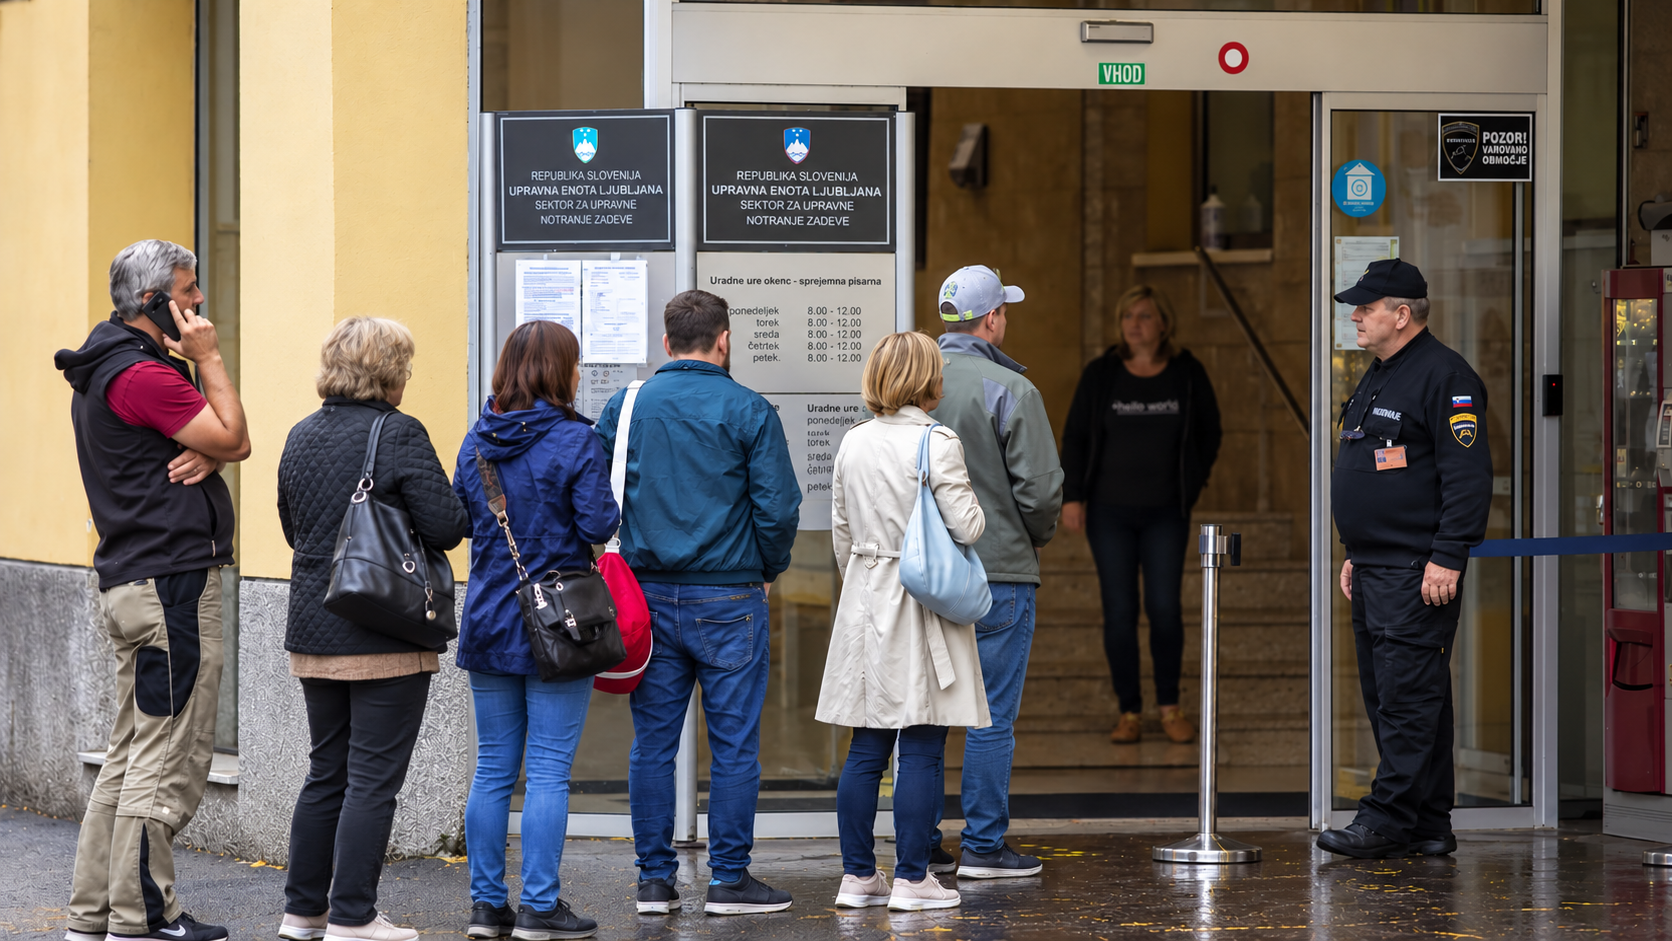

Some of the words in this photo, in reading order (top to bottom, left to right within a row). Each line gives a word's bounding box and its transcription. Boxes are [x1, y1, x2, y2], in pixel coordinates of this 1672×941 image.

[1103, 65, 1142, 83] VHOD
[1482, 131, 1527, 144] POZOR!
[531, 170, 585, 181] REPUBLIKA
[587, 170, 642, 181] SLOVENIJA
[736, 170, 797, 181] REPUBLIKA
[799, 171, 858, 182] SLOVENIJA
[509, 185, 559, 196] UPRAVNA
[561, 185, 597, 196] ENOTA
[599, 184, 663, 195] LJUBLJANA
[711, 184, 767, 196] UPRAVNA
[770, 185, 810, 196] ENOTA
[812, 186, 882, 197] LJUBLJANA
[535, 199, 574, 210] SEKTOR
[576, 199, 589, 210] ZA
[590, 199, 637, 210] UPRAVNE
[740, 199, 785, 211] SEKTOR
[786, 200, 801, 211] ZA
[803, 200, 854, 211] UPRAVNE
[540, 214, 592, 225] NOTRANJE
[594, 214, 633, 225] ZADEVE
[746, 215, 804, 226] NOTRANJE
[806, 215, 850, 226] ZADEVE
[709, 276, 745, 285] Uradne
[763, 276, 792, 285] okenc
[798, 276, 847, 288] sprejemna
[848, 276, 882, 288] pisarna
[729, 306, 780, 317] ponedeljek
[807, 306, 828, 316] 8.00
[837, 306, 862, 316] 12.00
[756, 317, 780, 327] torek
[807, 317, 828, 327] 8.00
[837, 317, 862, 327] 12.00
[753, 329, 780, 339] sreda
[807, 329, 828, 339] 8.00
[837, 329, 862, 339] 12.00
[747, 340, 780, 350] četrtek
[807, 341, 828, 351] 8.00
[837, 341, 862, 351] 12.00
[807, 353, 828, 363] 8.00
[837, 353, 862, 363] 12.00
[807, 403, 841, 413] Uradne
[843, 405, 859, 413] ure
[807, 416, 856, 427] ponedeljek
